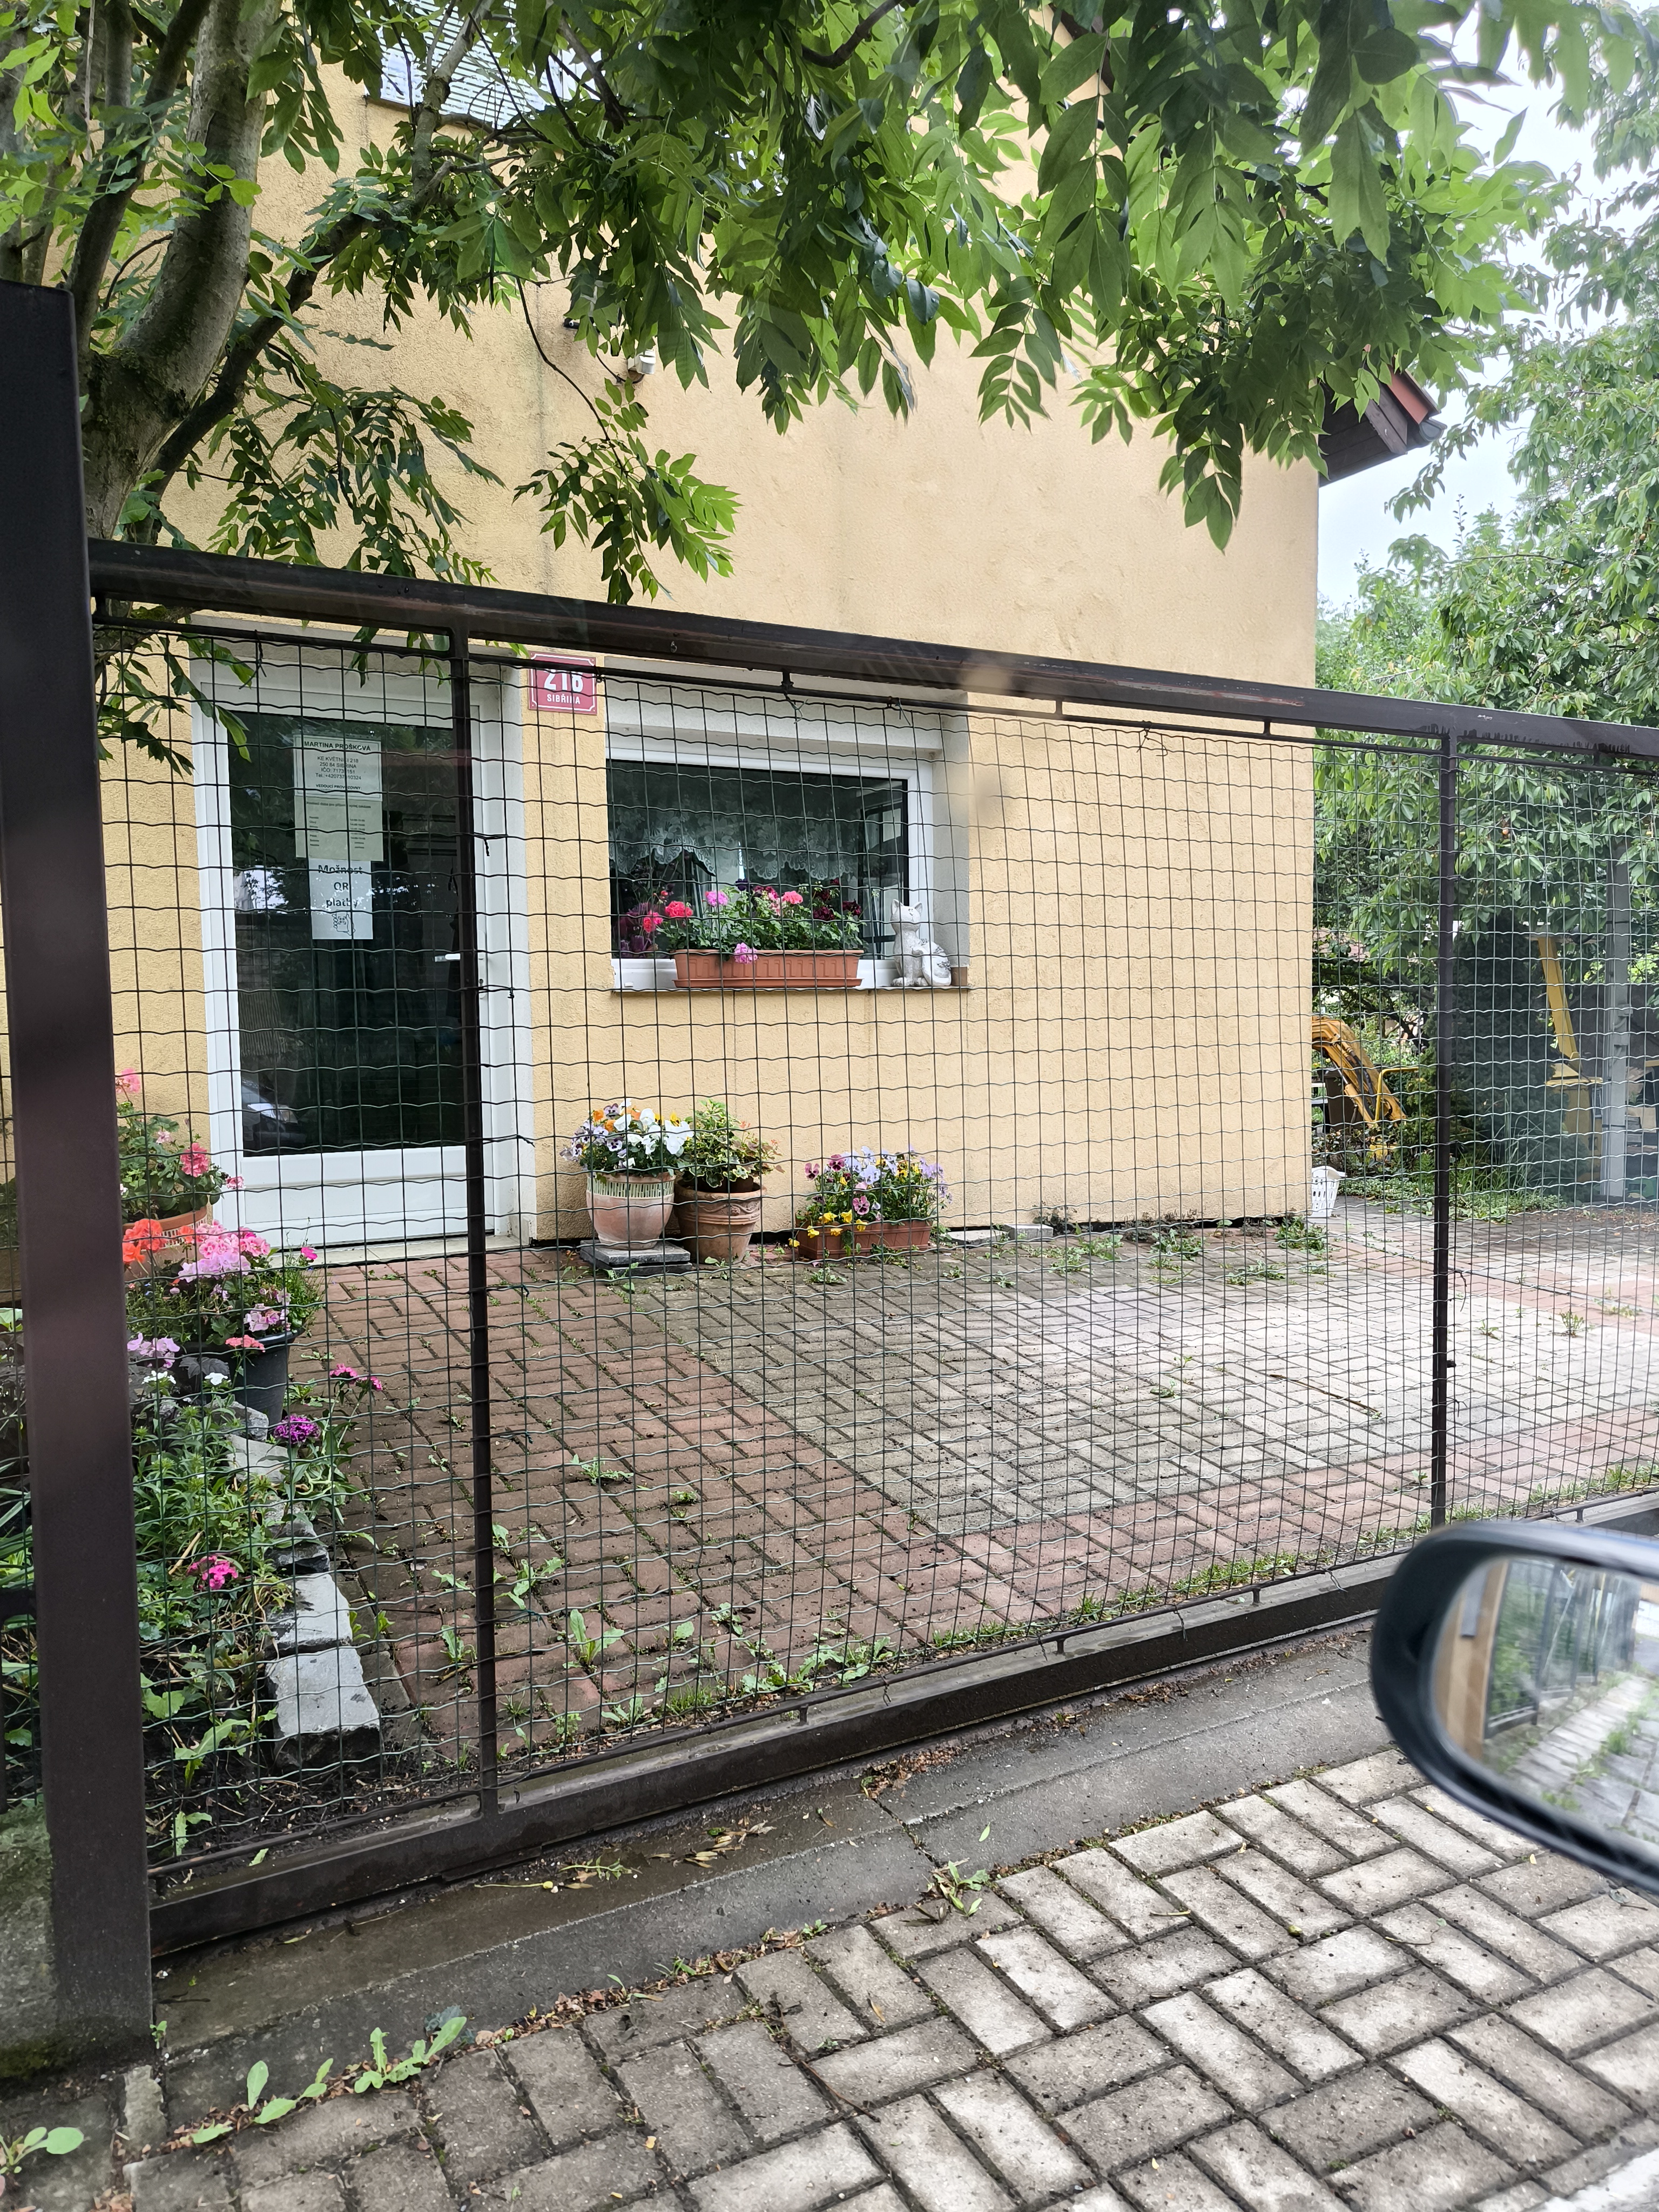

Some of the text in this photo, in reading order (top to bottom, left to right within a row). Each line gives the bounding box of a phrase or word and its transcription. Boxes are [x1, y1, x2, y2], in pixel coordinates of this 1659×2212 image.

[543, 667, 584, 692] 218
[547, 693, 581, 704] SIBŘINA
[335, 743, 371, 751] PROŠKOVÁ
[334, 882, 348, 891] QR
